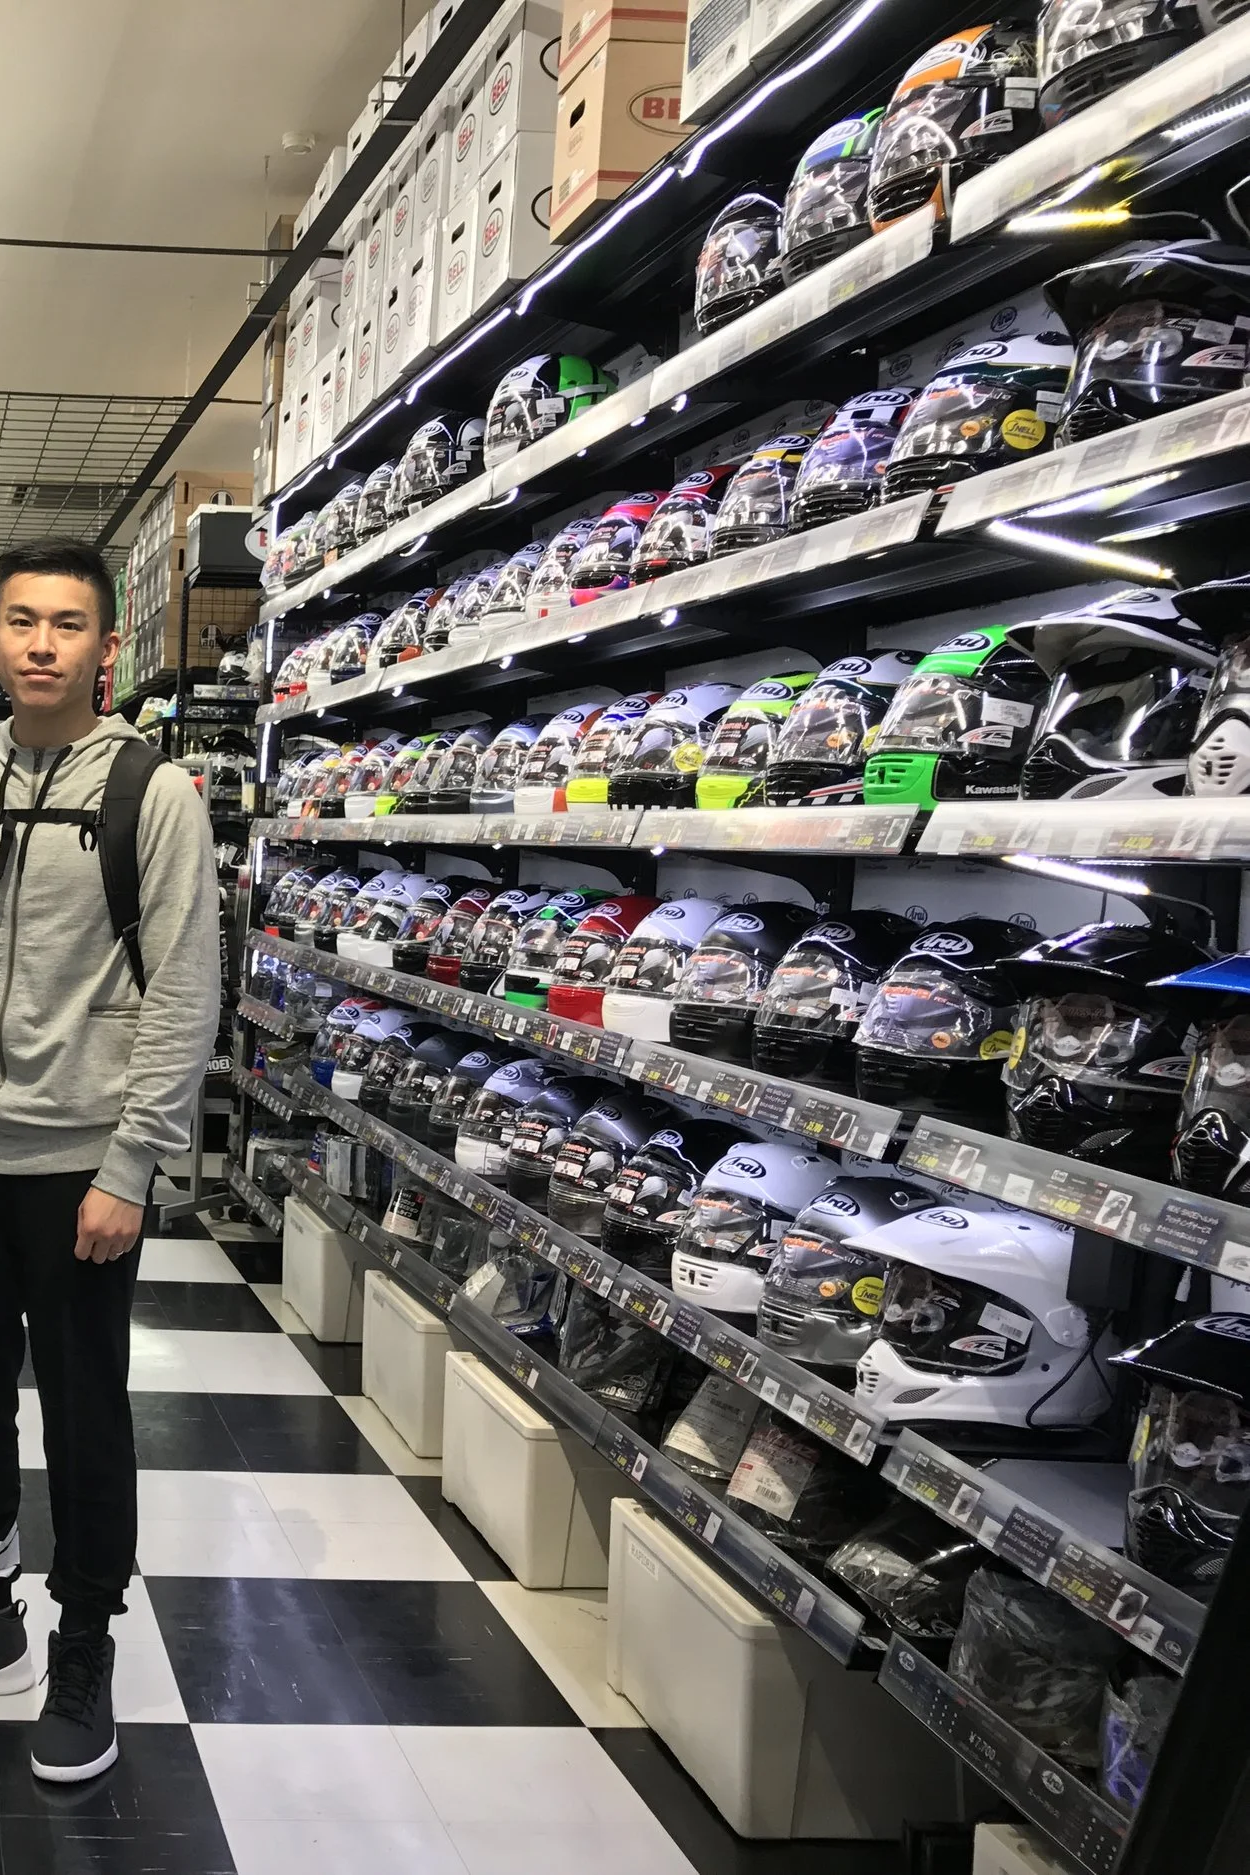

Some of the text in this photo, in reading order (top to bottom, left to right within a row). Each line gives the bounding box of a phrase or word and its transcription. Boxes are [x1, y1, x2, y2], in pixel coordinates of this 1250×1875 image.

[491, 70, 511, 100] BELL
[641, 96, 682, 120] BE
[457, 126, 474, 147] BELL
[483, 221, 501, 245] BELL
[447, 264, 466, 284] BELL
[1006, 419, 1037, 435] SNELL
[943, 633, 985, 650] Arai
[825, 658, 867, 674] Arai
[749, 683, 785, 697] Arai
[615, 697, 649, 711] Arai
[965, 783, 1021, 796] Kawasak
[655, 905, 683, 919] Arai
[723, 913, 759, 929] Arai
[811, 923, 851, 940] Arai
[918, 933, 968, 952] Arai
[461, 1052, 489, 1067] Arai
[721, 1157, 761, 1178] Arai
[818, 1193, 859, 1216] Arai
[928, 1210, 967, 1229] Arai
